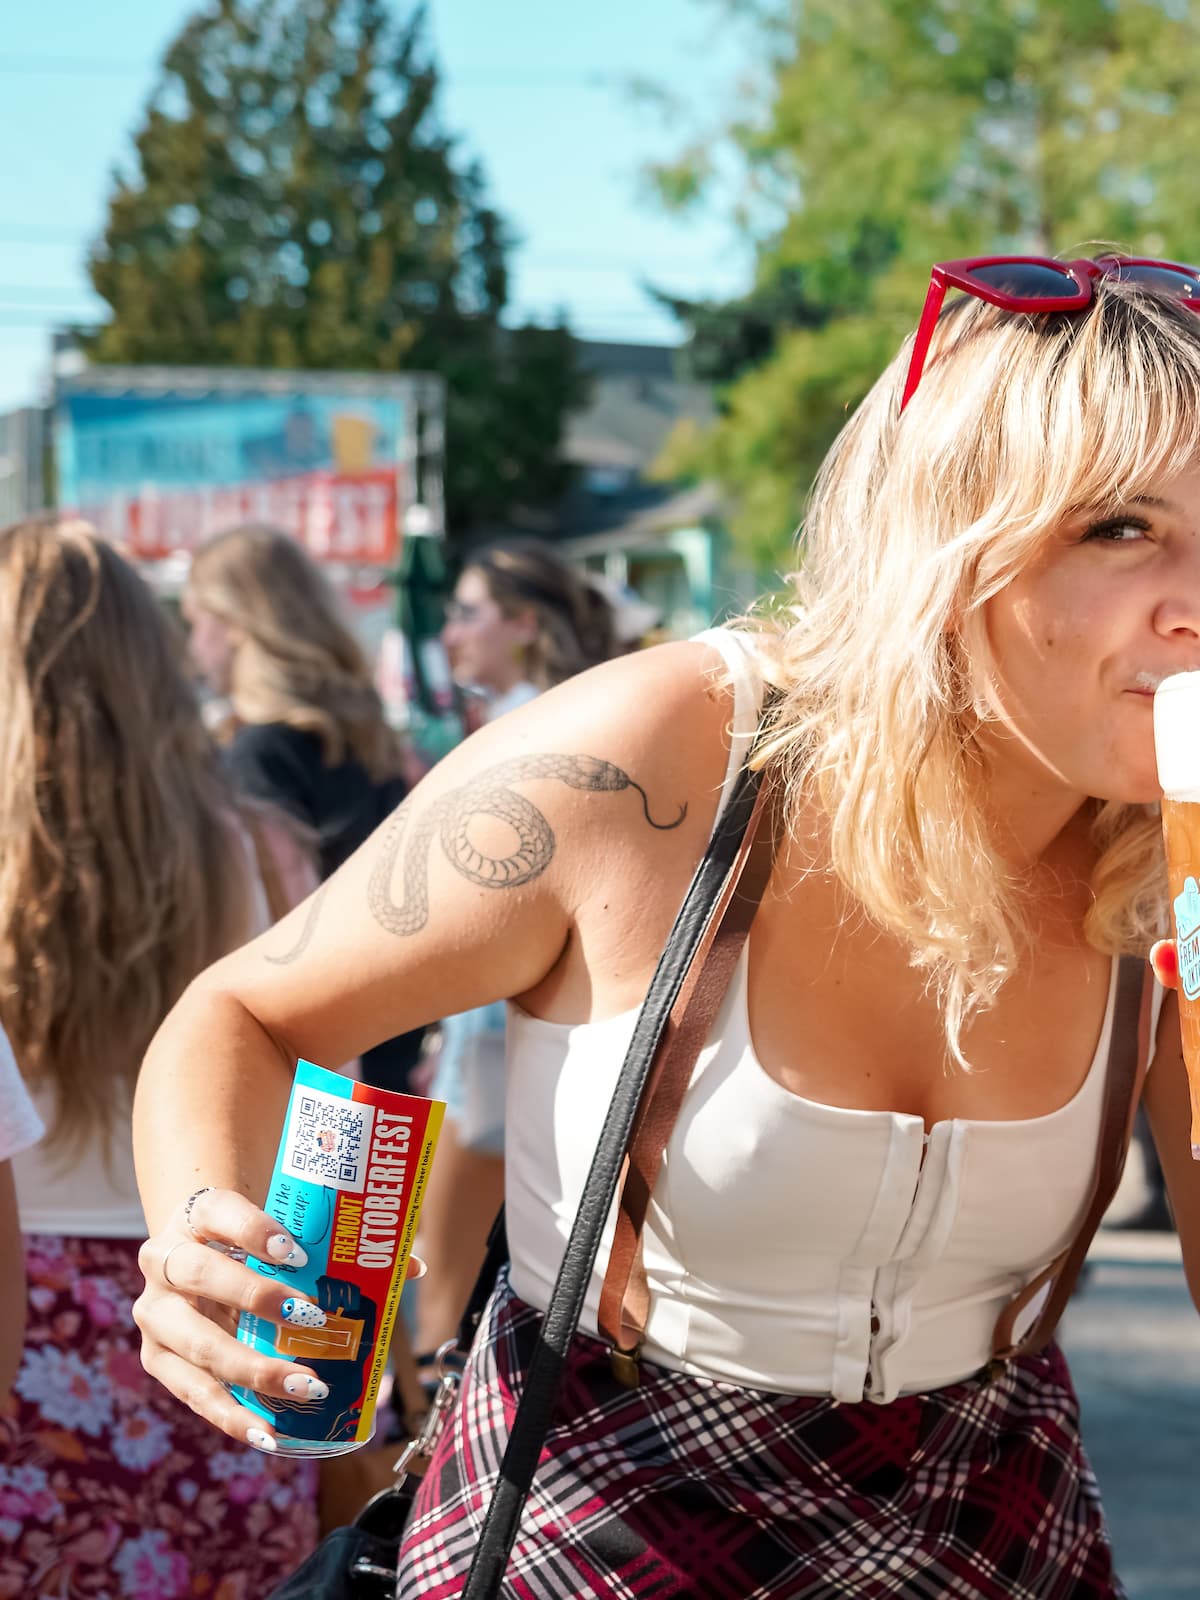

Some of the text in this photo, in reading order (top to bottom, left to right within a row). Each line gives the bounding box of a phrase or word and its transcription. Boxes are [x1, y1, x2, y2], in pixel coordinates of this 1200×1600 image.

[422, 1140, 432, 1166] tokens.
[416, 1168, 426, 1184] beer
[275, 1183, 291, 1205] the
[356, 1109, 413, 1269] OKTOBERFEST
[414, 1185, 422, 1204] more
[288, 1191, 310, 1239] Lineup:
[404, 1205, 419, 1243] purchasing
[332, 1195, 363, 1264] FREMONT
[400, 1243, 408, 1262] when
[392, 1264, 403, 1293] discount
[384, 1316, 391, 1325] to
[387, 1301, 395, 1317] earn
[371, 1358, 382, 1385] ONTAP
[367, 1386, 376, 1402] Text
